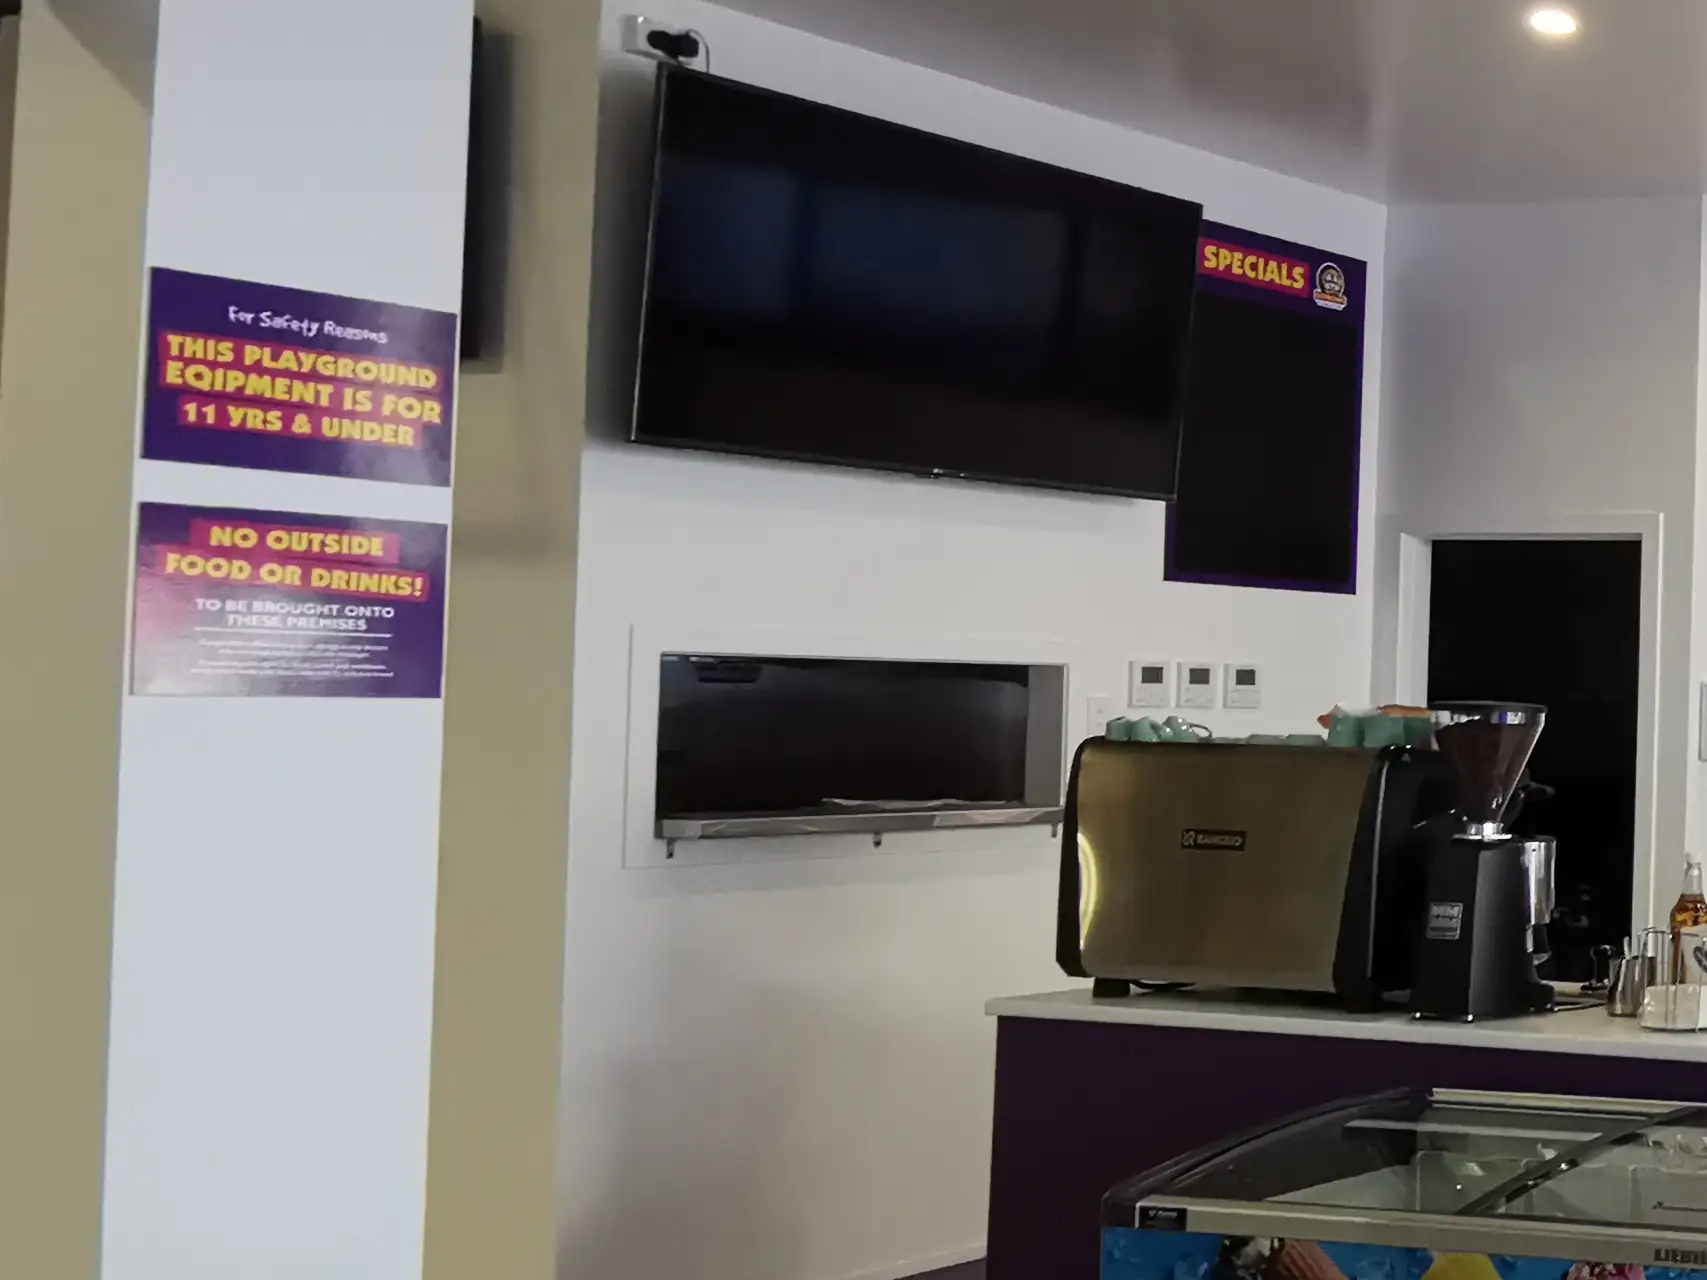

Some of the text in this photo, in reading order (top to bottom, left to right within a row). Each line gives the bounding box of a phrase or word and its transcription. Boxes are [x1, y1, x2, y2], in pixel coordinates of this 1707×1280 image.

[1203, 245, 1304, 289] SPECIALS
[228, 305, 388, 344] For Safety Reasons
[166, 335, 437, 389] THIS PLAYGROUND
[165, 362, 442, 425] EQIPMENT IS FOR
[183, 403, 416, 446] 11 YRS & UNDER
[209, 526, 384, 557] NO OUTSIDE
[165, 553, 424, 597] FOOD OR DRINKS!
[196, 598, 395, 618] TO BE BROUGHT ONTO
[226, 614, 368, 631] THESE PREMISES
